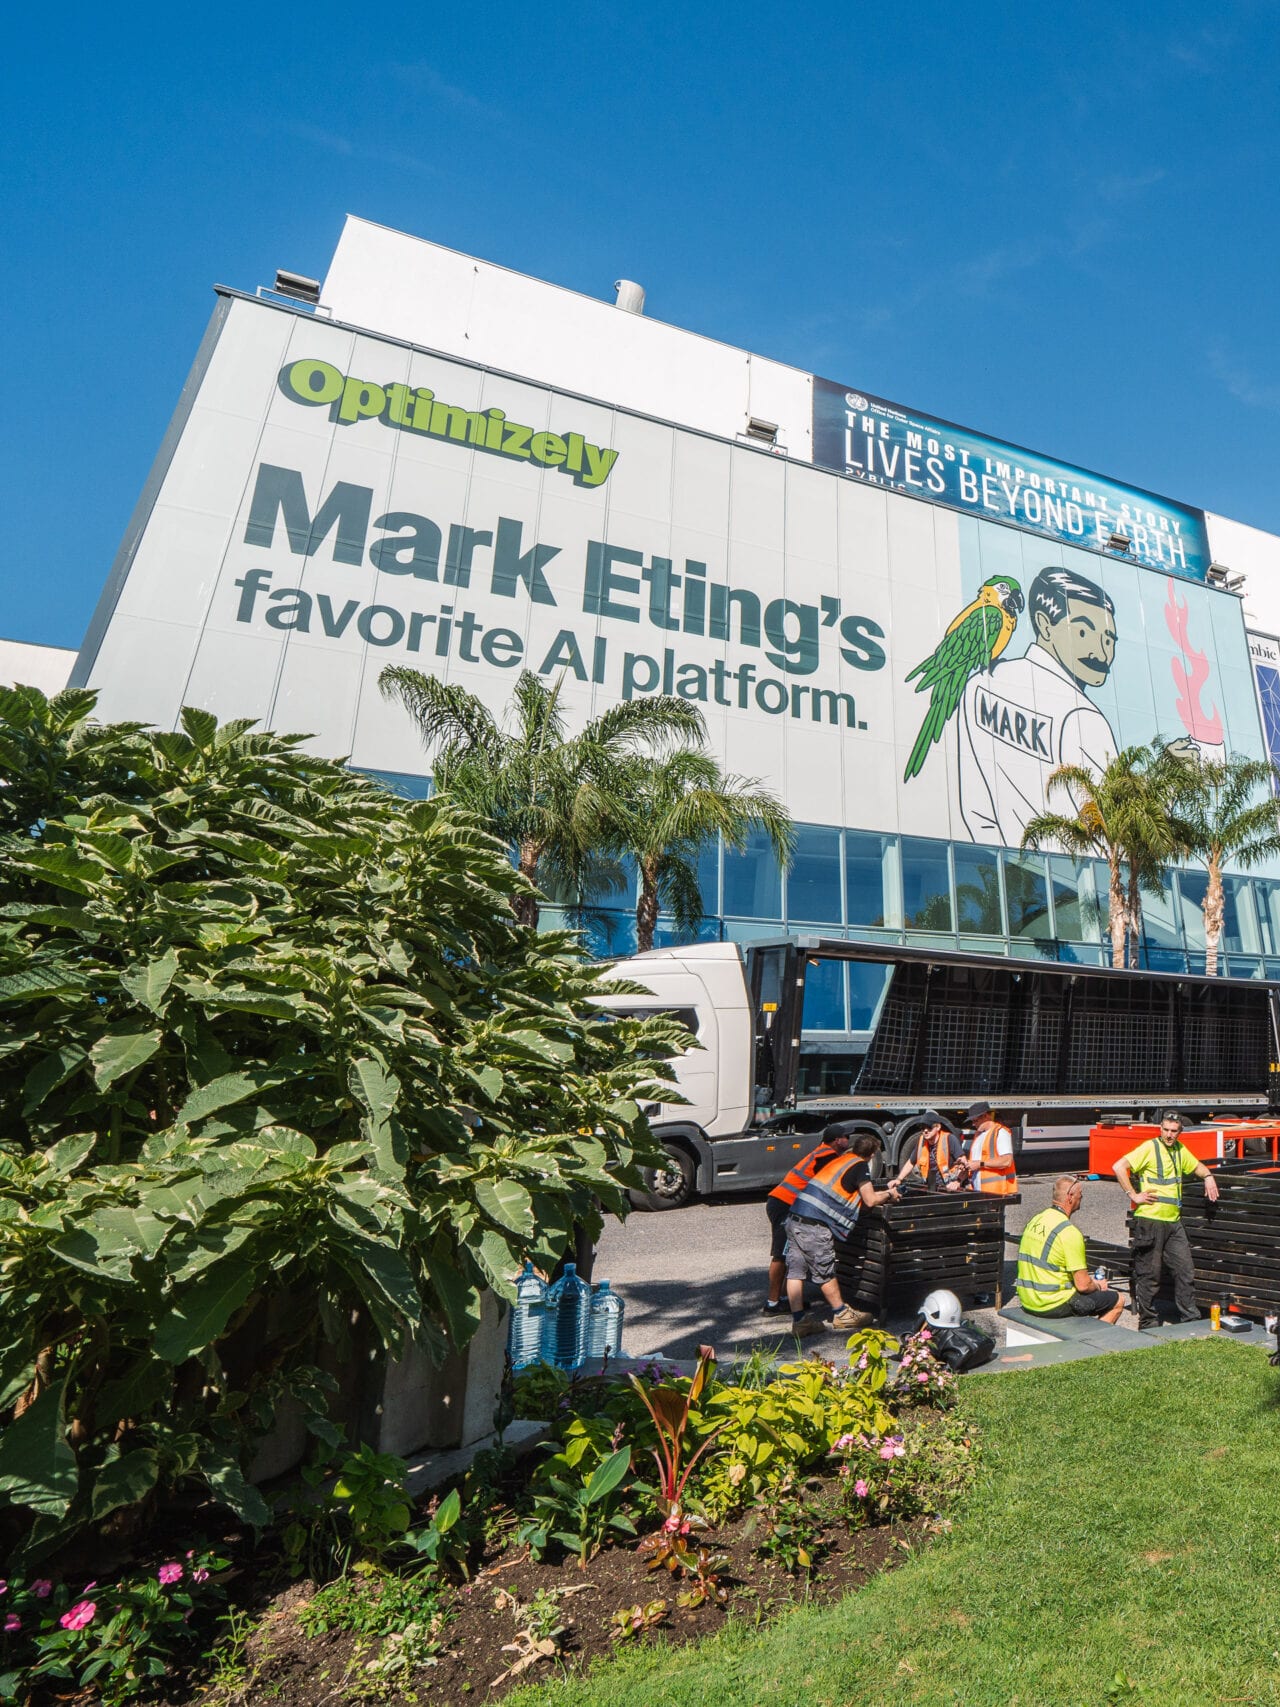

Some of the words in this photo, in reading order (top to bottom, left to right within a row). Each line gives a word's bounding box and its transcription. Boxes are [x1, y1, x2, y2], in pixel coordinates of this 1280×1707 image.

[278, 359, 620, 490] Optimizely
[844, 410, 890, 440] THE
[906, 430, 971, 466] MOST
[985, 457, 1108, 512] IMPORTANT
[1120, 502, 1181, 536] STORY
[243, 462, 563, 608] Mark
[845, 428, 946, 493] LIVES
[959, 466, 1084, 536] BEYOND
[1094, 510, 1187, 569] EARTH
[234, 568, 524, 668] favorite
[537, 628, 607, 685] AI
[621, 647, 868, 731] platform.
[980, 692, 1049, 757] MARK
